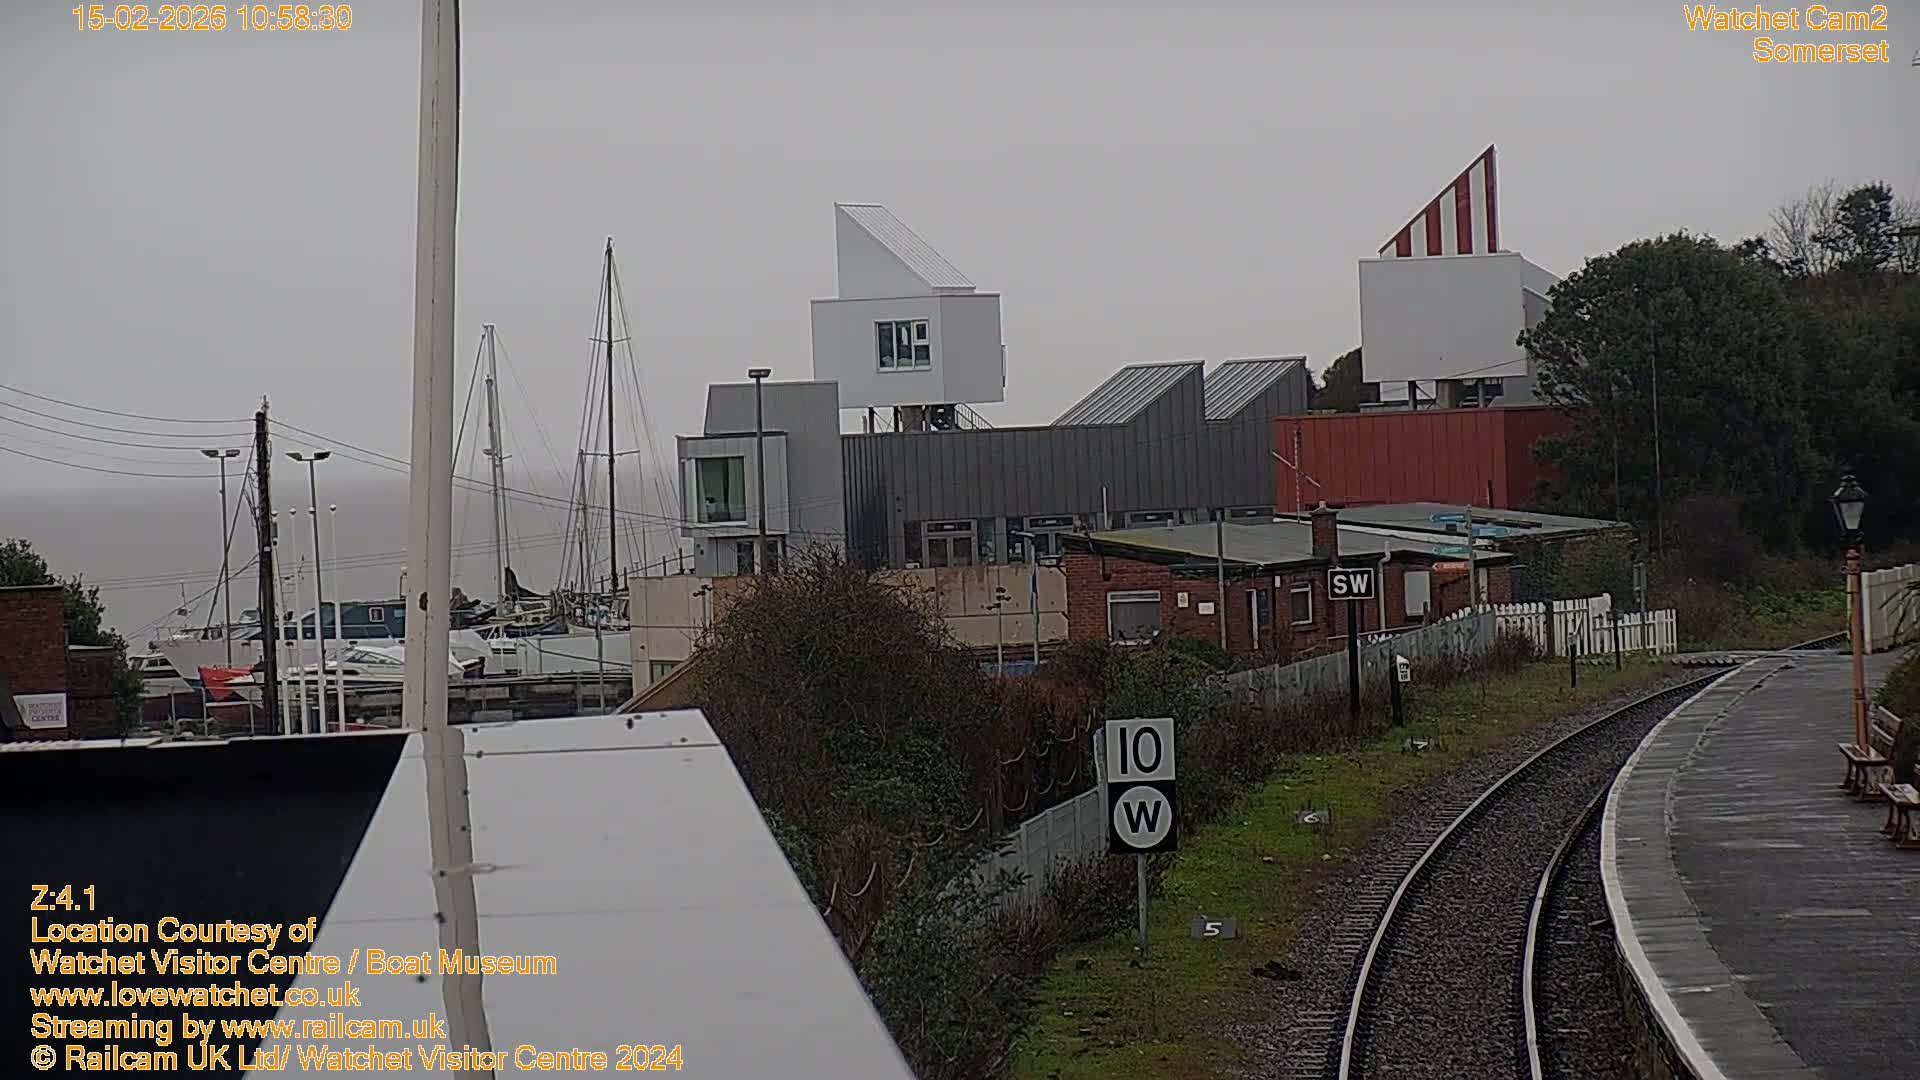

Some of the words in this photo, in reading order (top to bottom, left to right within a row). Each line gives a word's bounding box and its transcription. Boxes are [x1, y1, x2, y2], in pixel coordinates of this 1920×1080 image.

[1333, 574, 1369, 595] SW
[1119, 726, 1162, 775] 10
[1122, 800, 1162, 834] W
[1303, 812, 1320, 823] 6
[1203, 922, 1222, 937] 5
